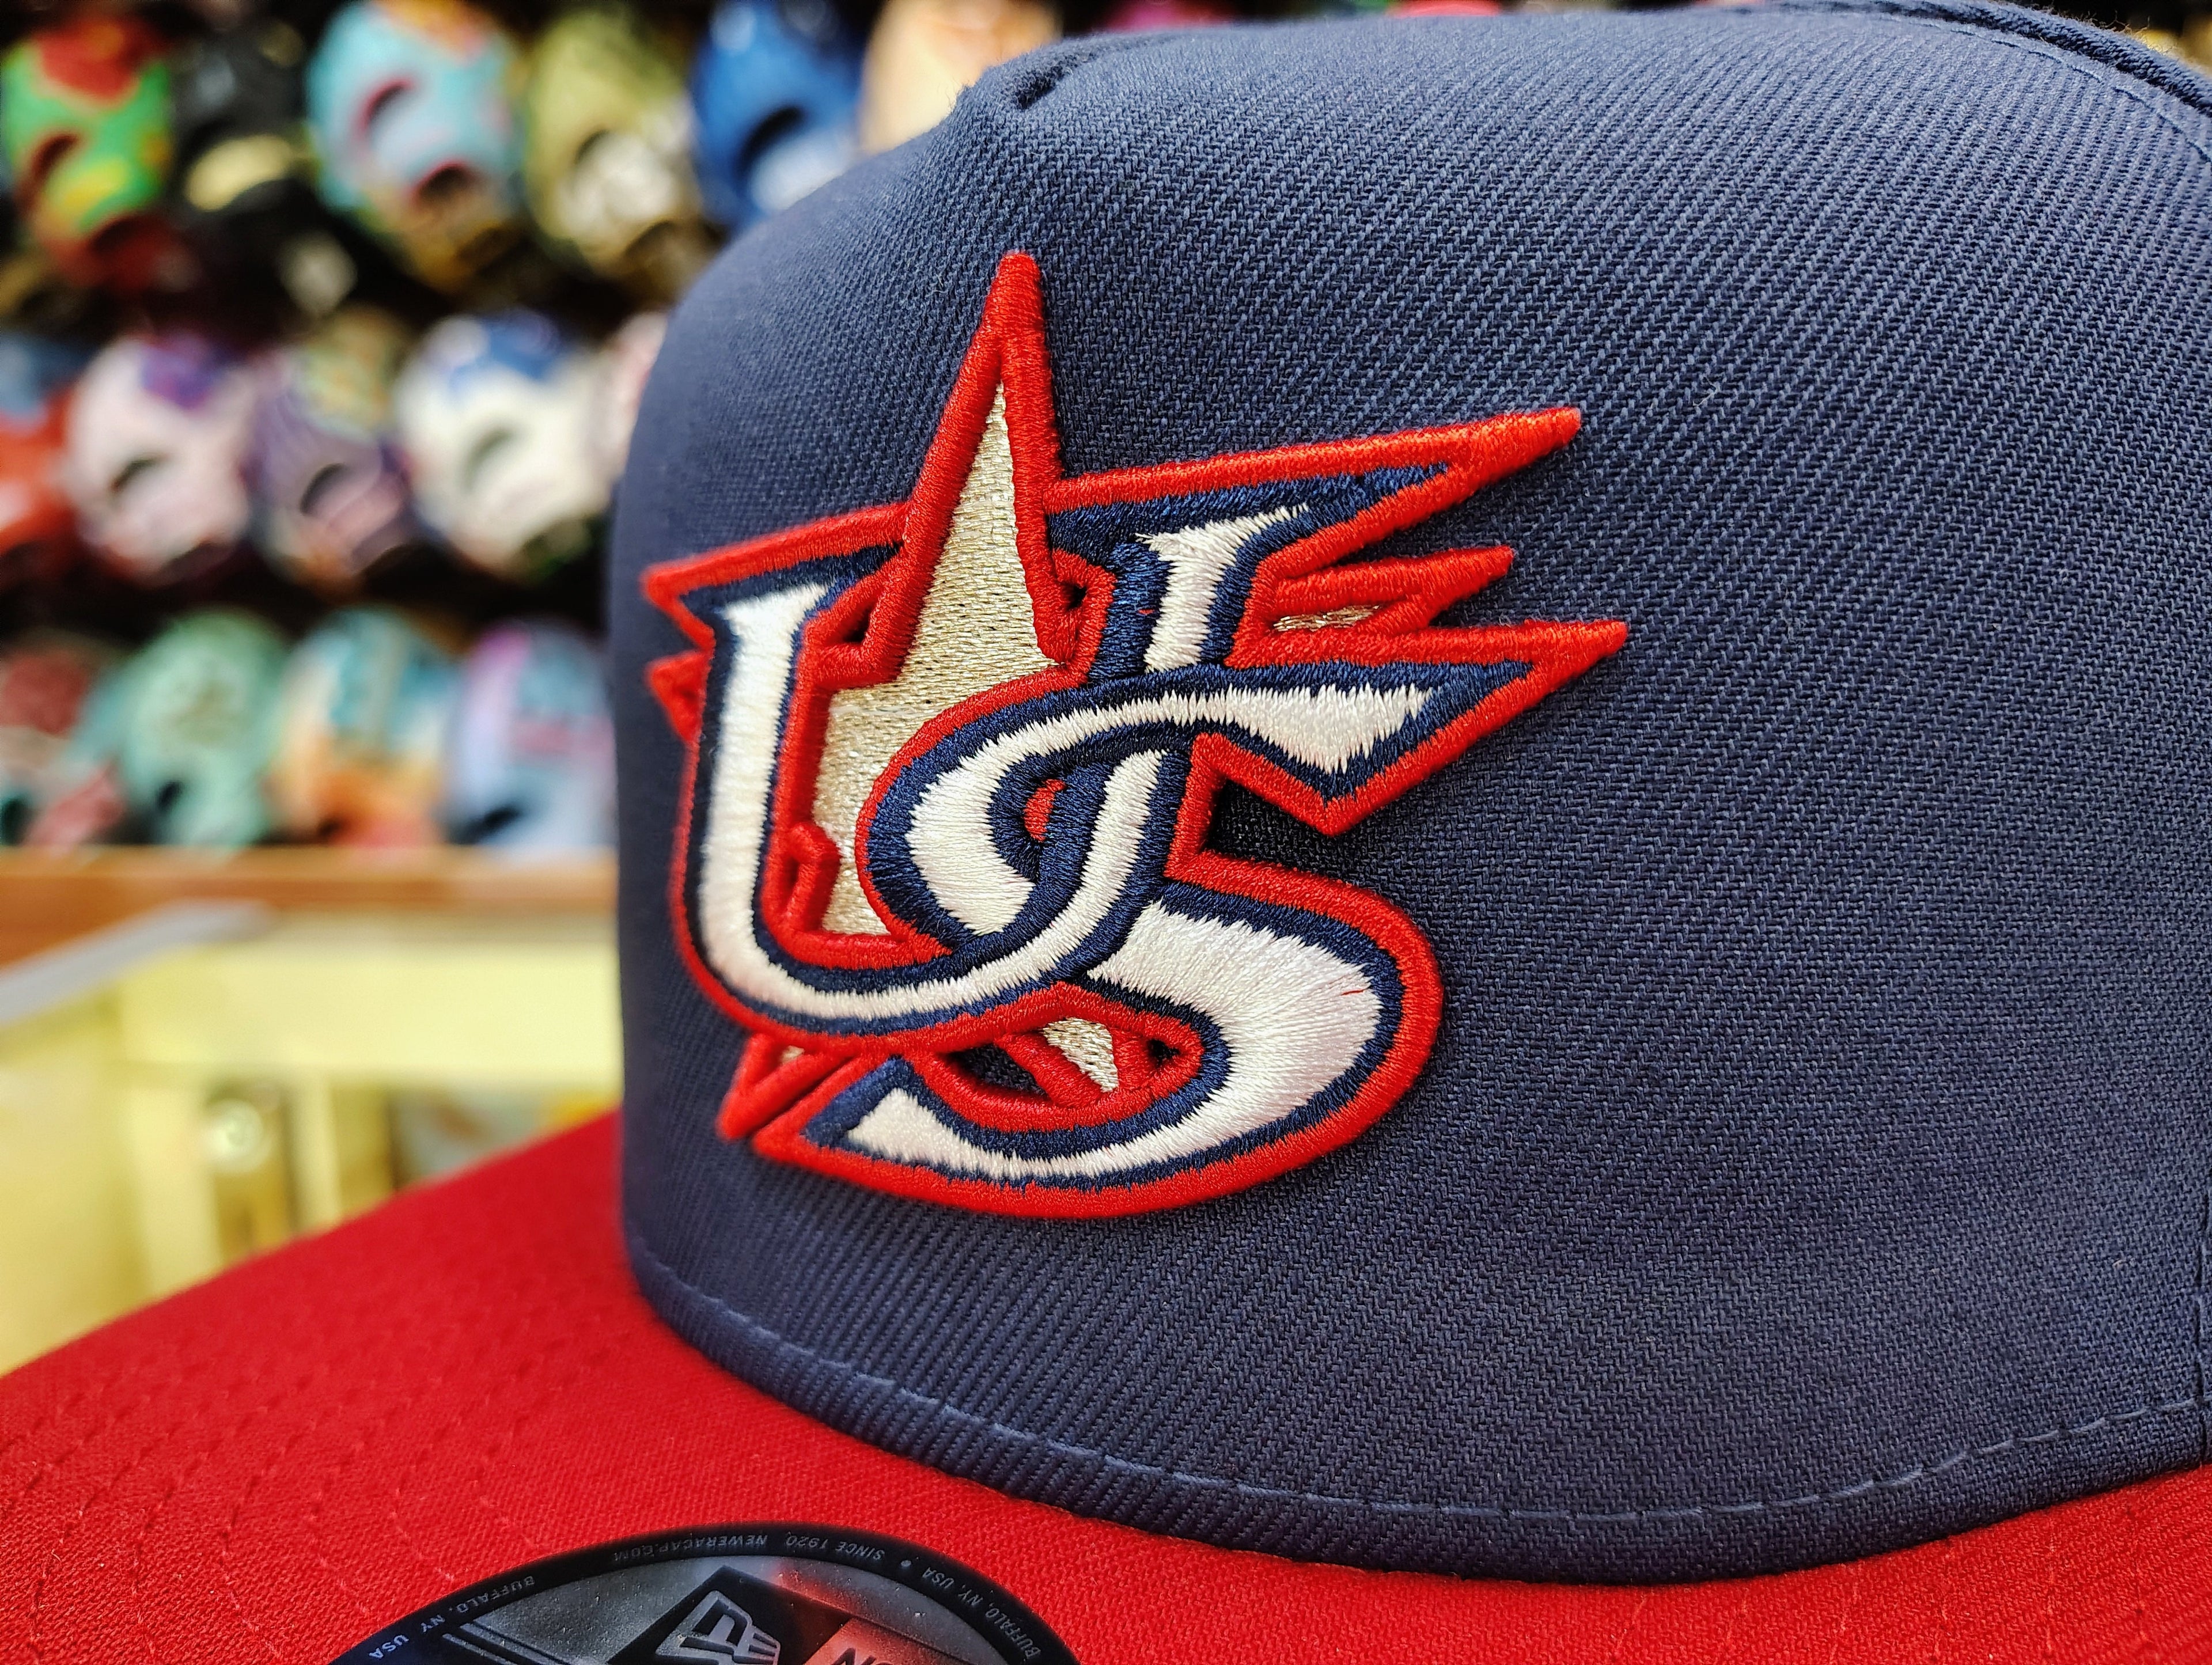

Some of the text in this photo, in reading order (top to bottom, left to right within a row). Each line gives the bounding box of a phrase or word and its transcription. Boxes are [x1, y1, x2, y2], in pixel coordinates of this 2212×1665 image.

[613, 1534, 768, 1561] NEWERACAP.COM
[835, 1541, 885, 1560] SINCE
[922, 1567, 955, 1589] USA
[368, 1634, 410, 1659] USA
